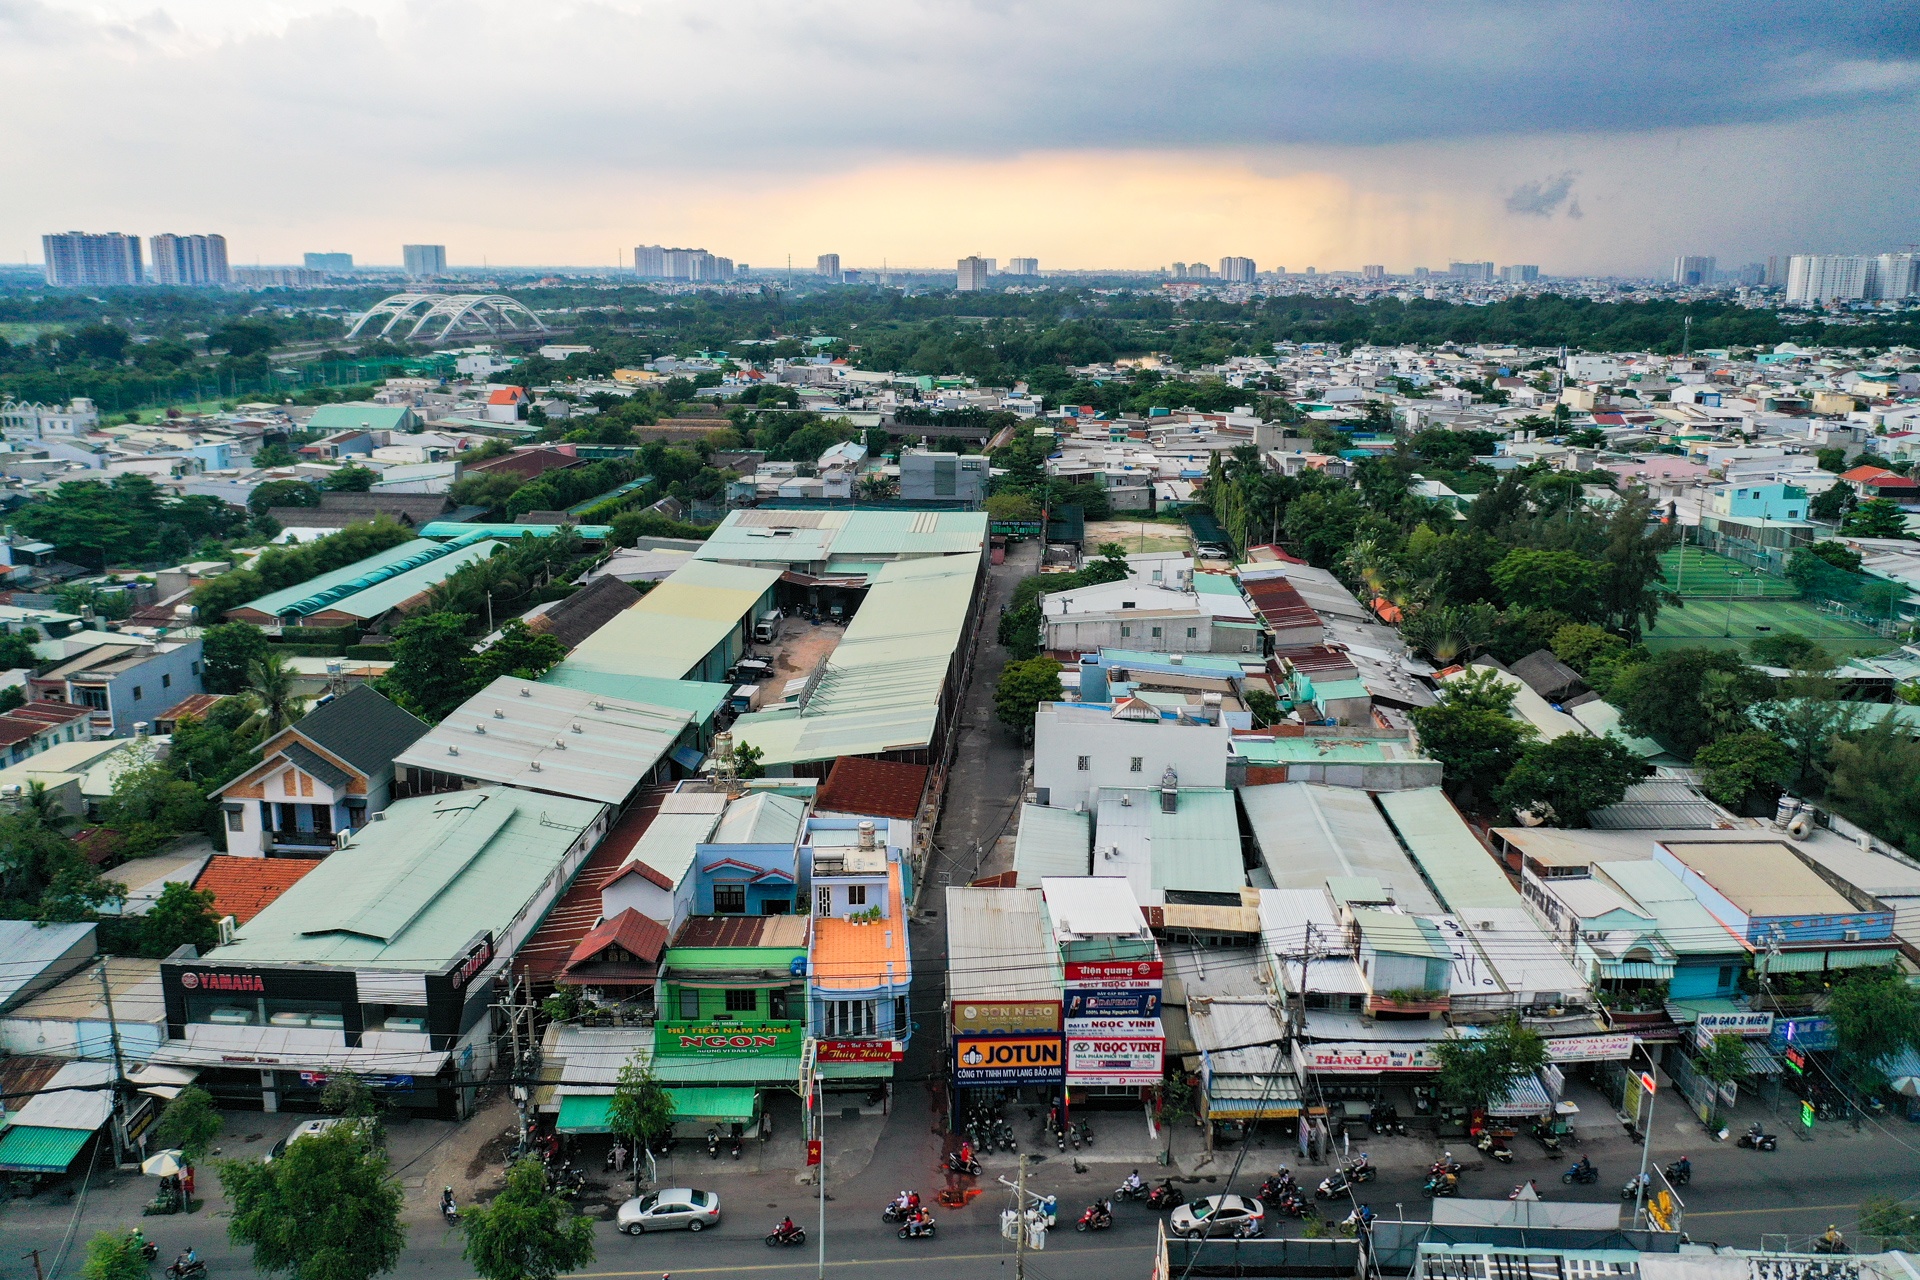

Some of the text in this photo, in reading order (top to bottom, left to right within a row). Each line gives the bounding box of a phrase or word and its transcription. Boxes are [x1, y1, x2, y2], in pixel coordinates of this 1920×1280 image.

[460, 944, 490, 982] YAMAHA
[1104, 967, 1133, 976] quang
[199, 973, 264, 991] YAMAHA
[1102, 981, 1126, 989] NGỌC
[1015, 1007, 1052, 1016] NERO
[1738, 1016, 1745, 1025] 3
[1746, 1013, 1770, 1025] MIỀN
[679, 1036, 777, 1047] NGON
[1094, 1042, 1160, 1054] NGỌC VINH
[985, 1045, 1057, 1064] JOTUN
[1366, 1054, 1389, 1066] LỢI
[958, 1066, 1061, 1078] CÔNG TY TNHH MTV LANG BẢO ANH
